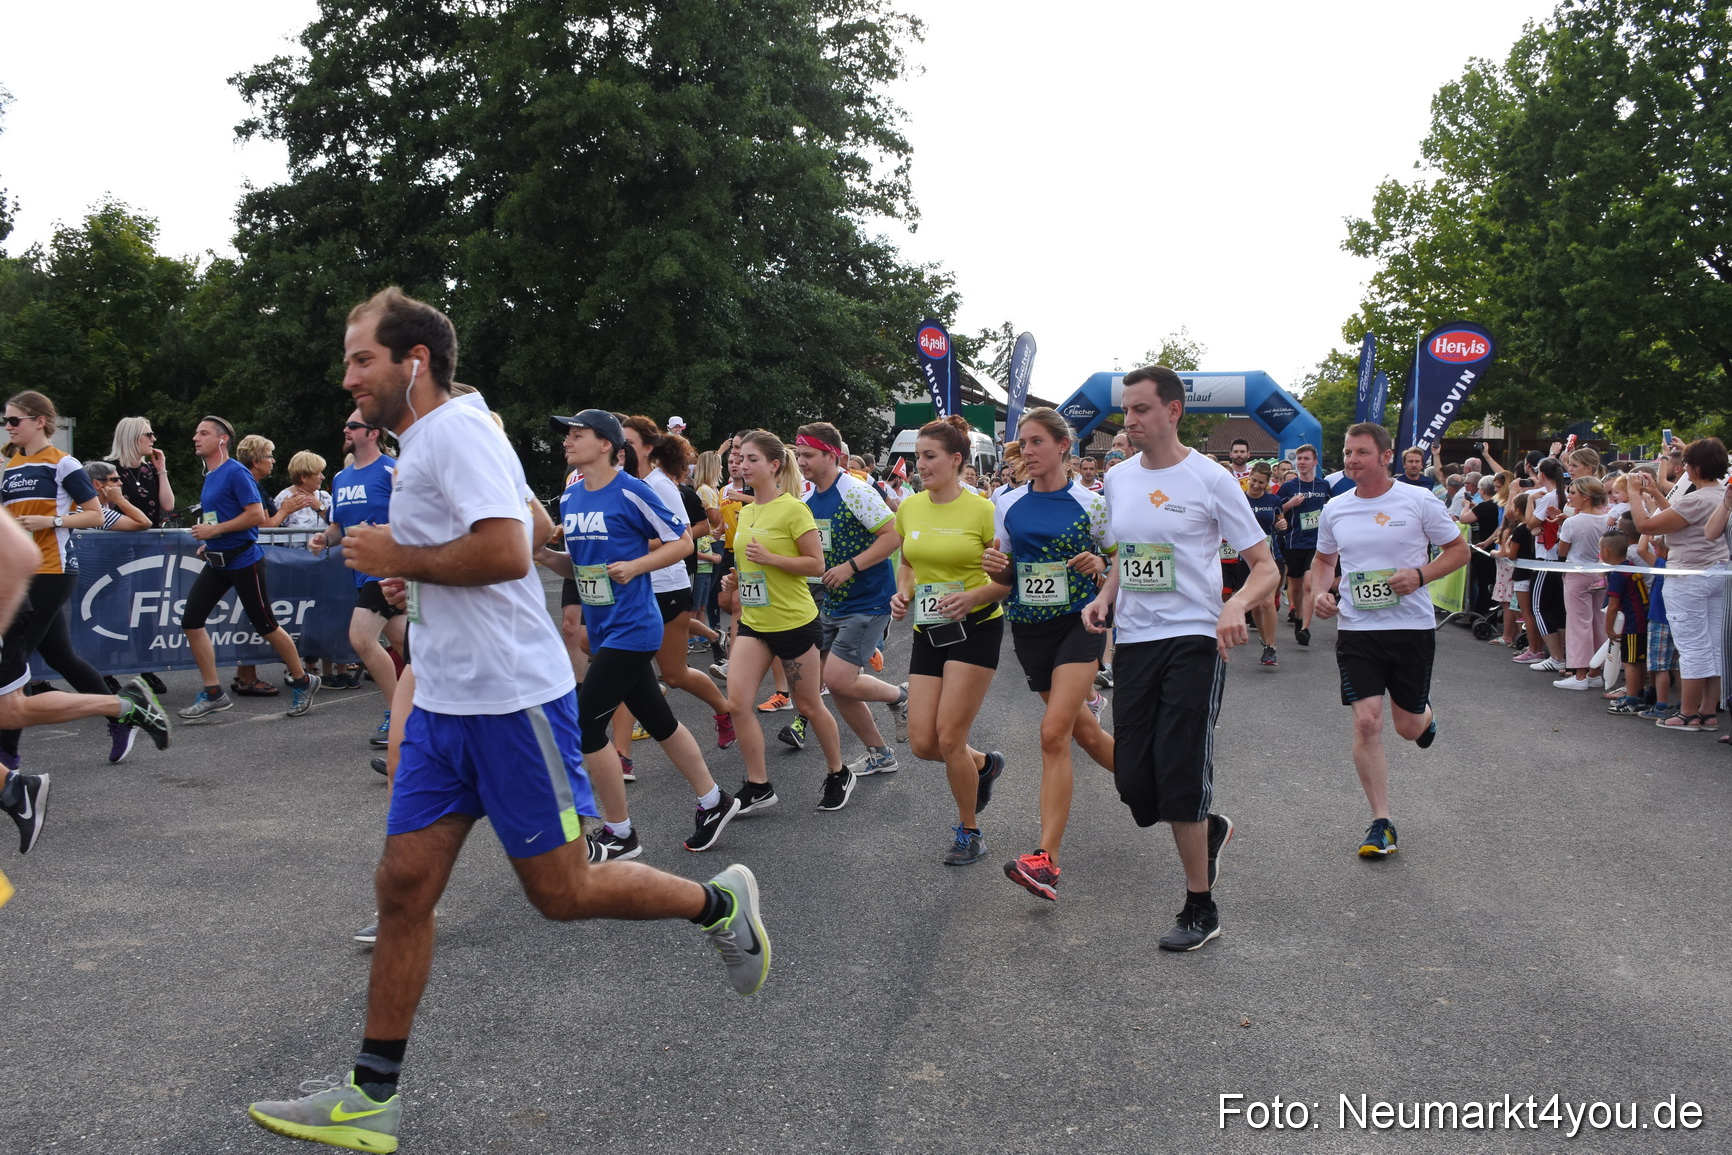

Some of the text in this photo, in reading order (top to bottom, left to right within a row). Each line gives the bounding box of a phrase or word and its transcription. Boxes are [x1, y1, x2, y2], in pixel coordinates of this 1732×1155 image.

[1435, 338, 1485, 357] Hervis
[1186, 392, 1212, 401] nlauf
[9, 479, 39, 488] Fischer
[337, 485, 367, 503] DVA
[564, 511, 608, 535] DVA
[1305, 516, 1319, 525] 713
[1123, 560, 1163, 577] 1341
[1025, 578, 1055, 593] 222
[1355, 583, 1392, 598] 1353
